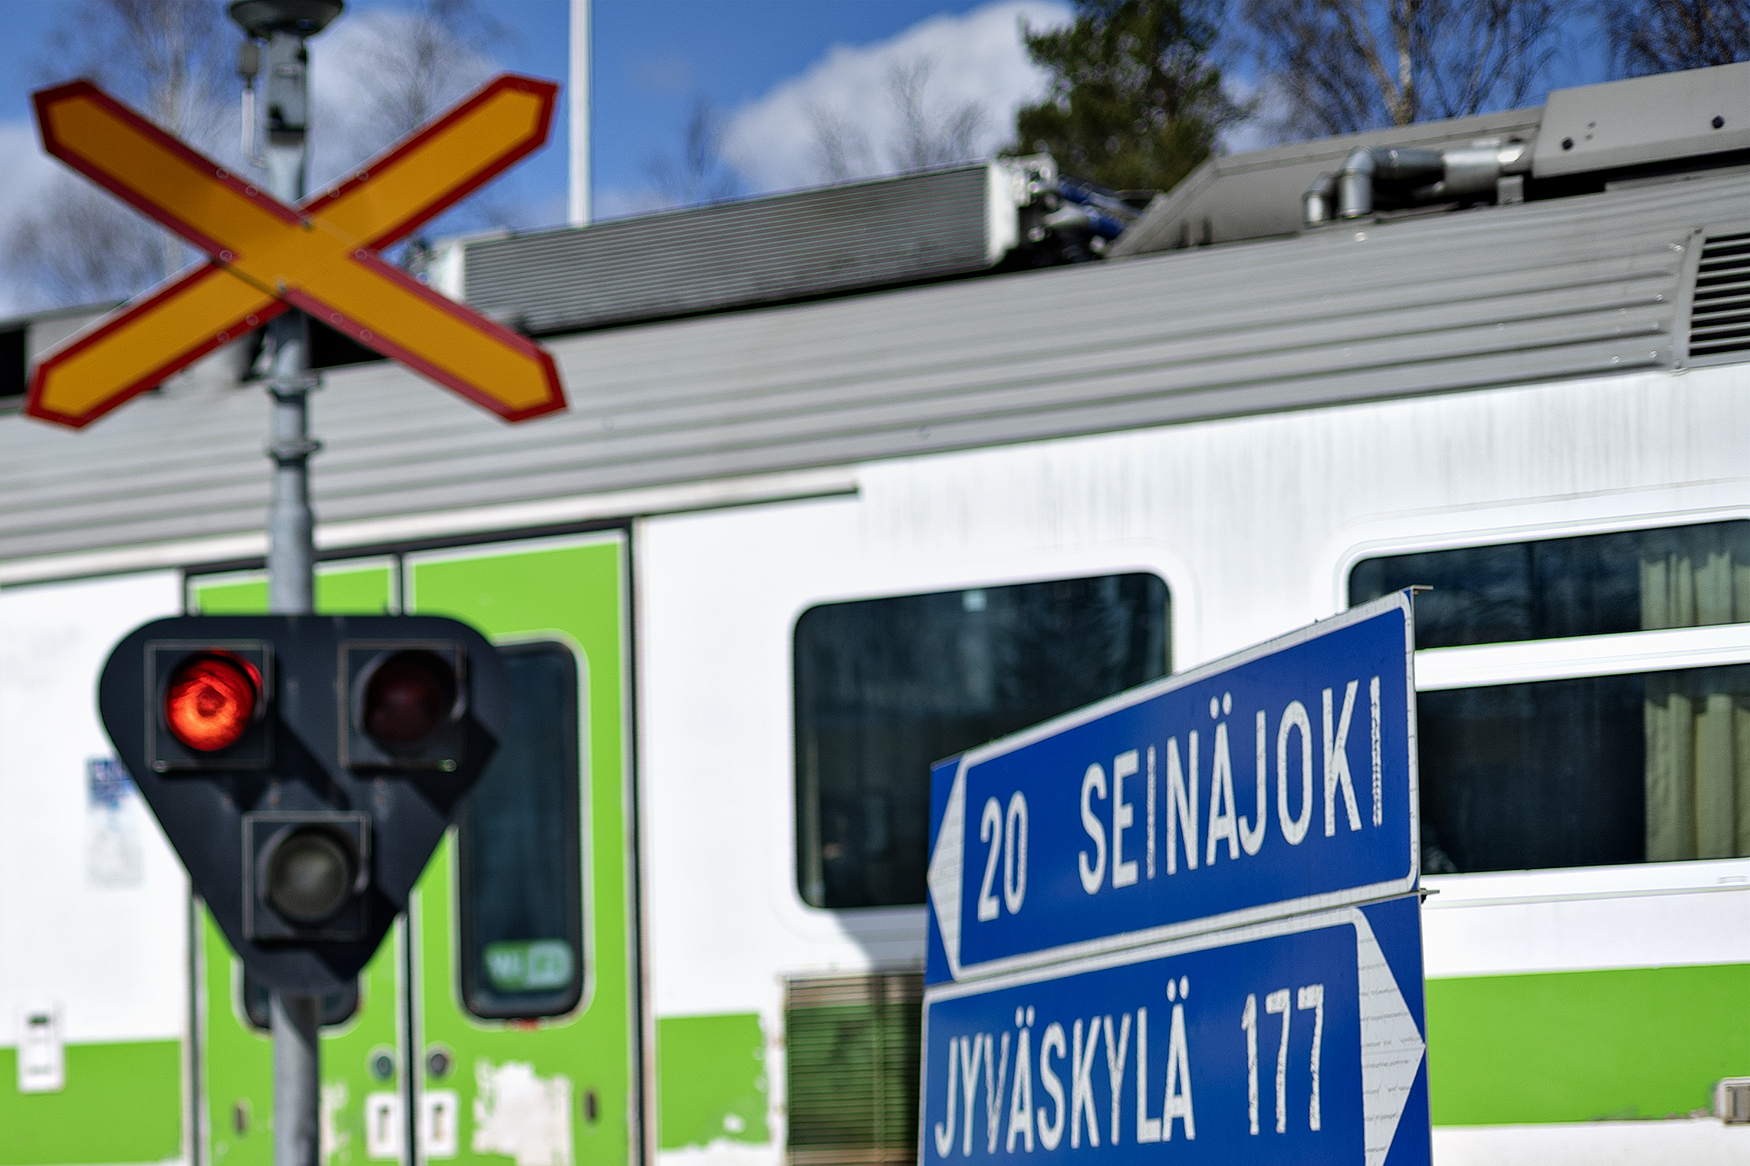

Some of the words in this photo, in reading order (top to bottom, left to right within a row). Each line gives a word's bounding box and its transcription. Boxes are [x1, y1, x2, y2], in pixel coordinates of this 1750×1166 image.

[978, 790, 1029, 922] 20
[1078, 676, 1383, 895] SEINÄJOKI
[934, 974, 1196, 1159] JYVÄSKYLÄ
[1241, 983, 1325, 1136] 177
